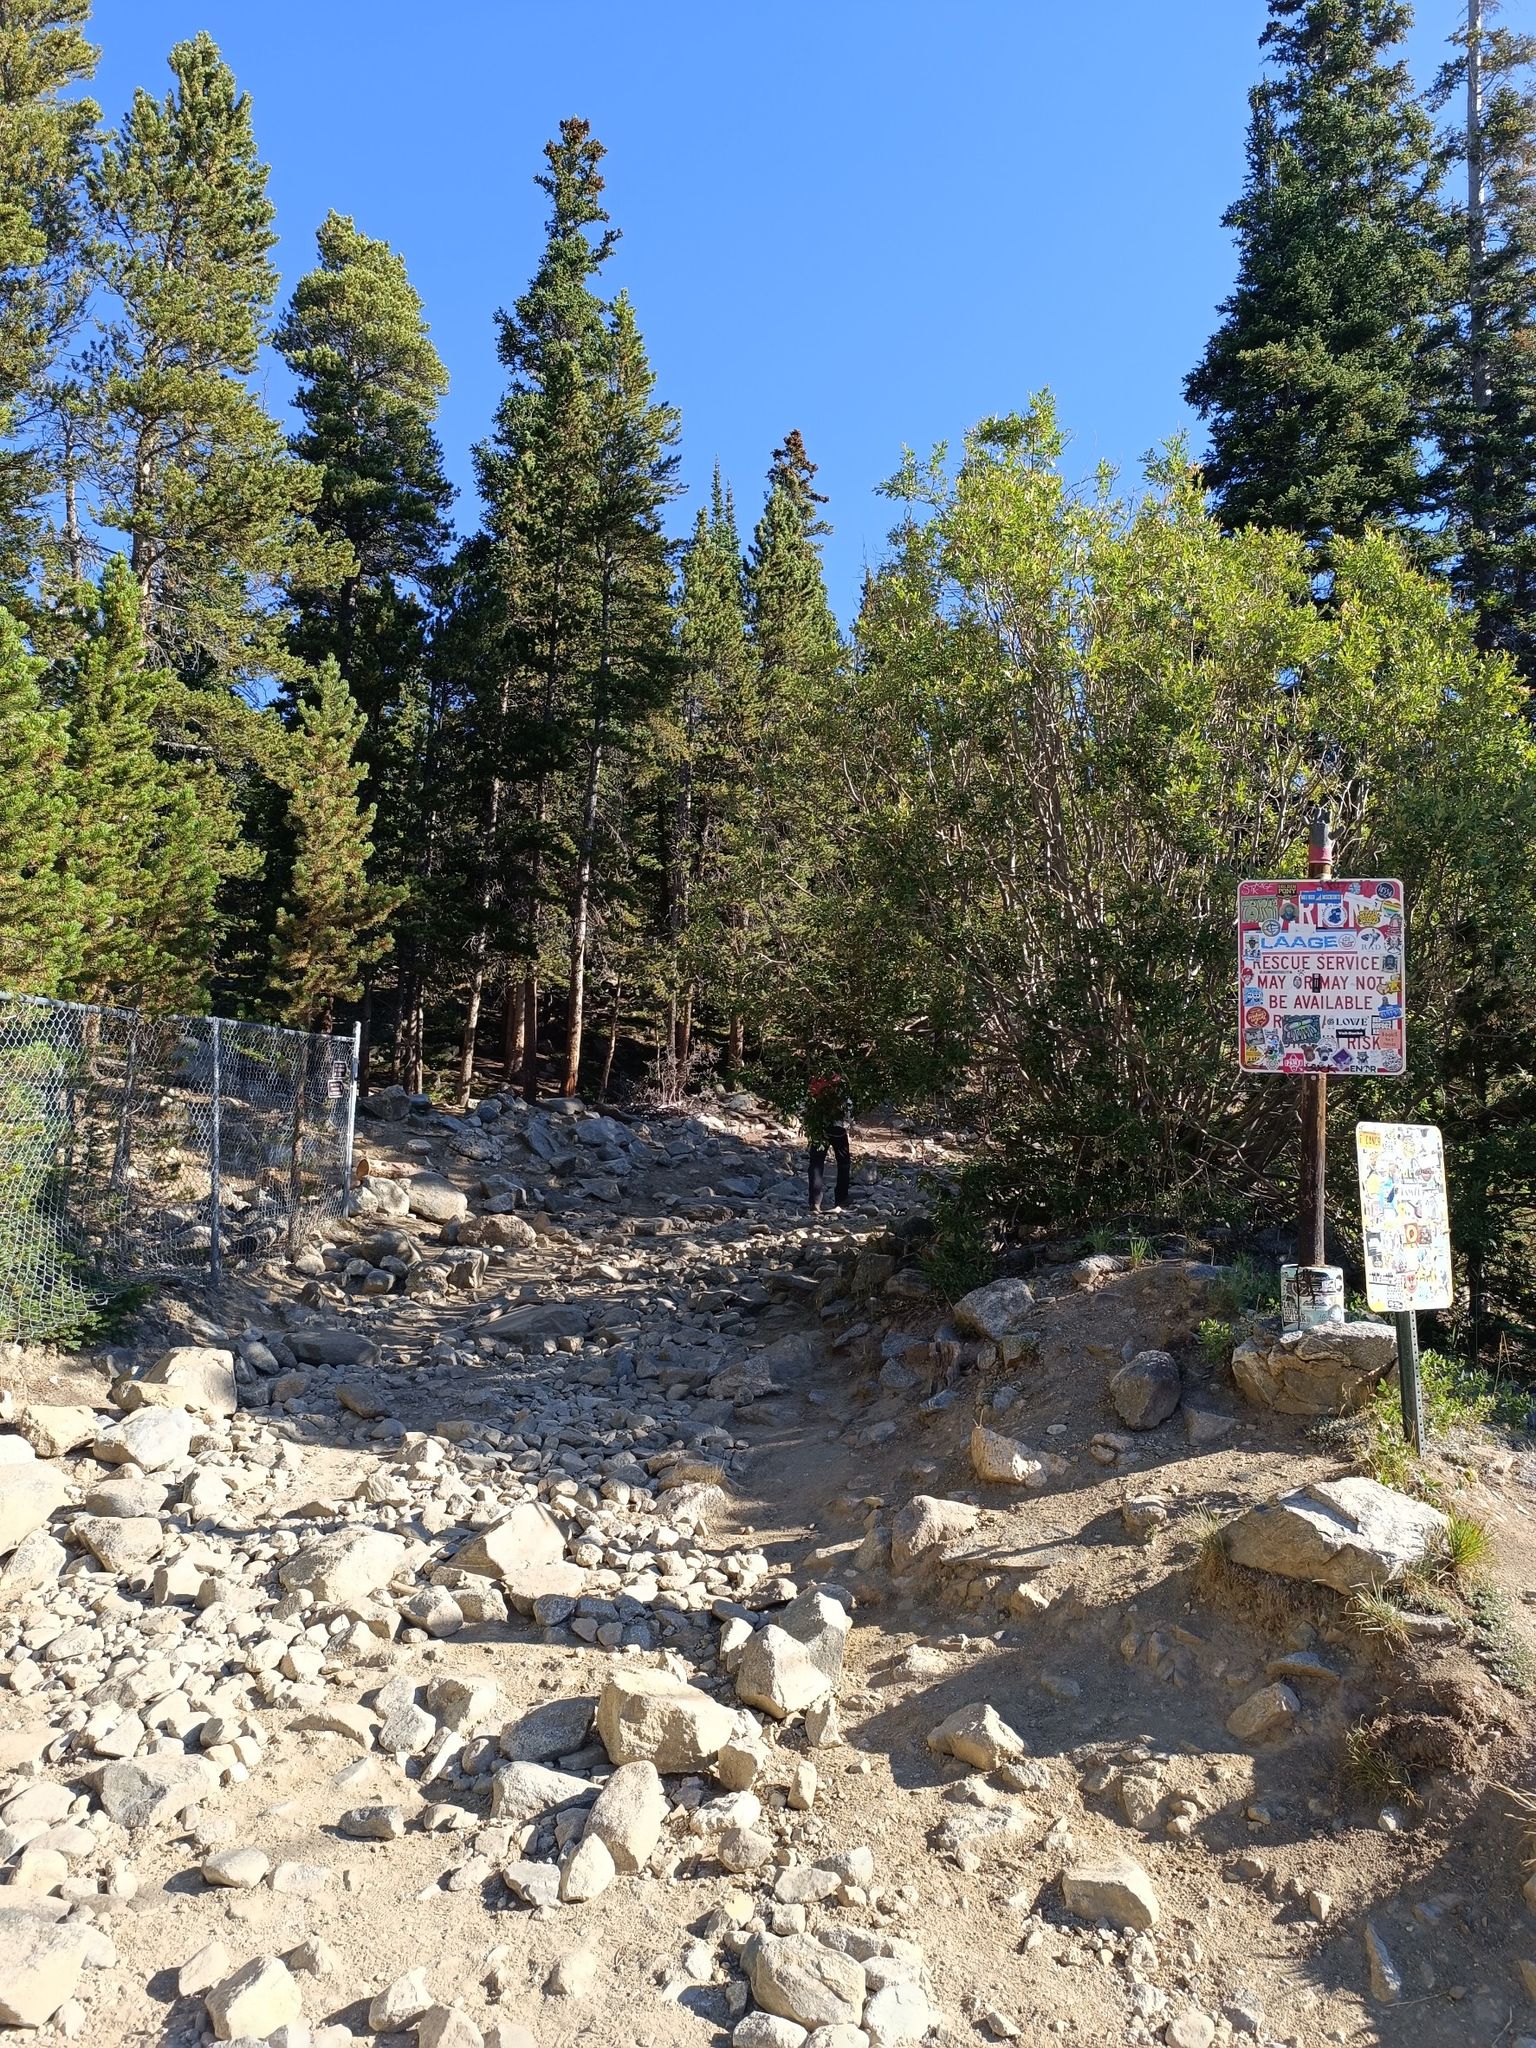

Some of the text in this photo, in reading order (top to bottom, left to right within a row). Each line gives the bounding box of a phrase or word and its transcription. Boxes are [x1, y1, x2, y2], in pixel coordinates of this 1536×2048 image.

[1260, 936, 1338, 949] LAAGE
[1316, 956, 1380, 970] SERVICE
[1257, 975, 1286, 990] MAY
[1320, 975, 1349, 990] MAY
[1356, 976, 1384, 991] NOT
[1269, 994, 1373, 1010] BE AVAILABLE
[1347, 1035, 1381, 1051] RISK
